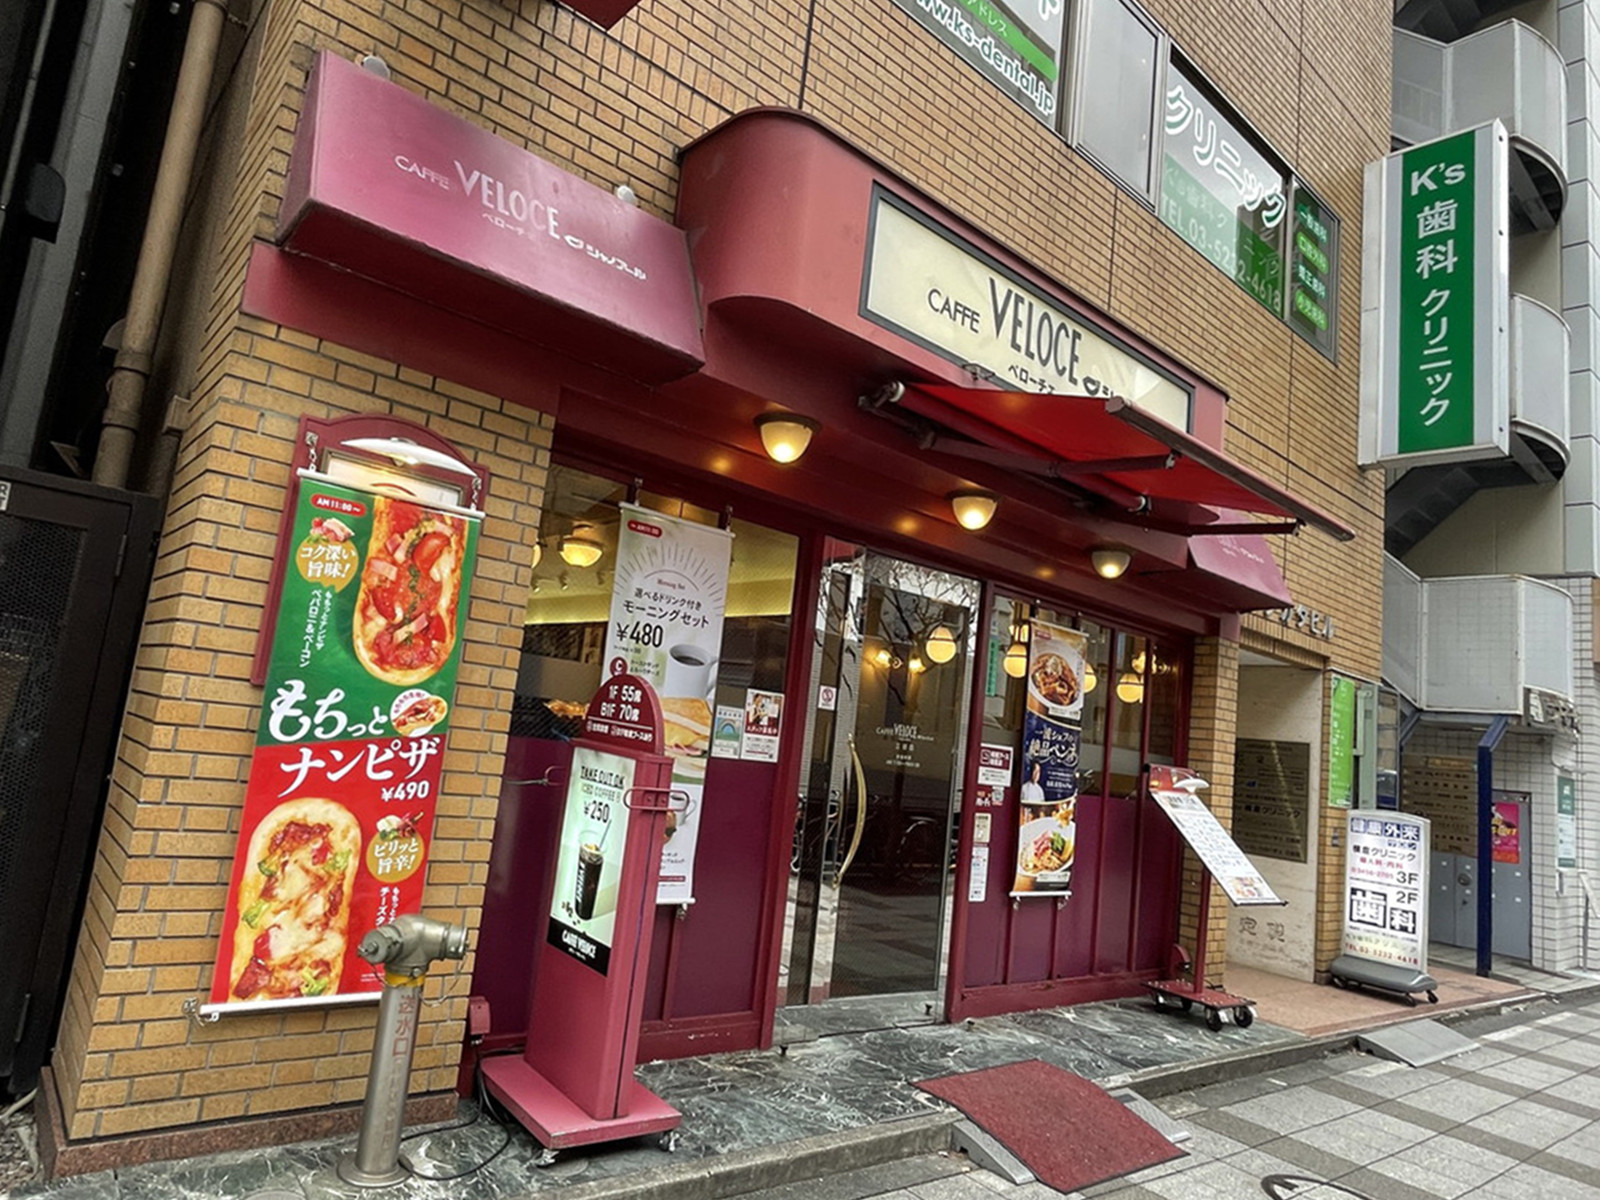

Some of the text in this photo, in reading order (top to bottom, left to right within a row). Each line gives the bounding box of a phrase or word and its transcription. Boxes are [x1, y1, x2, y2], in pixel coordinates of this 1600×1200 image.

[966, 0, 1008, 37] ドレス
[1164, 85, 1286, 228] クリニック
[394, 155, 560, 240] CAFFE VELOCE
[482, 212, 532, 238] ベローチ
[927, 276, 1083, 387] CAFFE VELOCE
[1007, 364, 1056, 395] ベローチェ
[300, 544, 356, 561] コク深い
[633, 587, 703, 611] 選べるドリンク付き
[622, 599, 710, 630] モーニングセット
[615, 620, 664, 648] ¥480
[609, 685, 618, 700] 1F
[268, 679, 389, 742] もちっと
[277, 736, 441, 798] ナンピザ
[380, 780, 430, 802] ¥490
[584, 799, 610, 823] ¥250
[374, 837, 419, 857] ピリッと
[1396, 870, 1419, 885] 3F
[1350, 887, 1417, 935] 歯科
[1396, 890, 1418, 906] 2F
